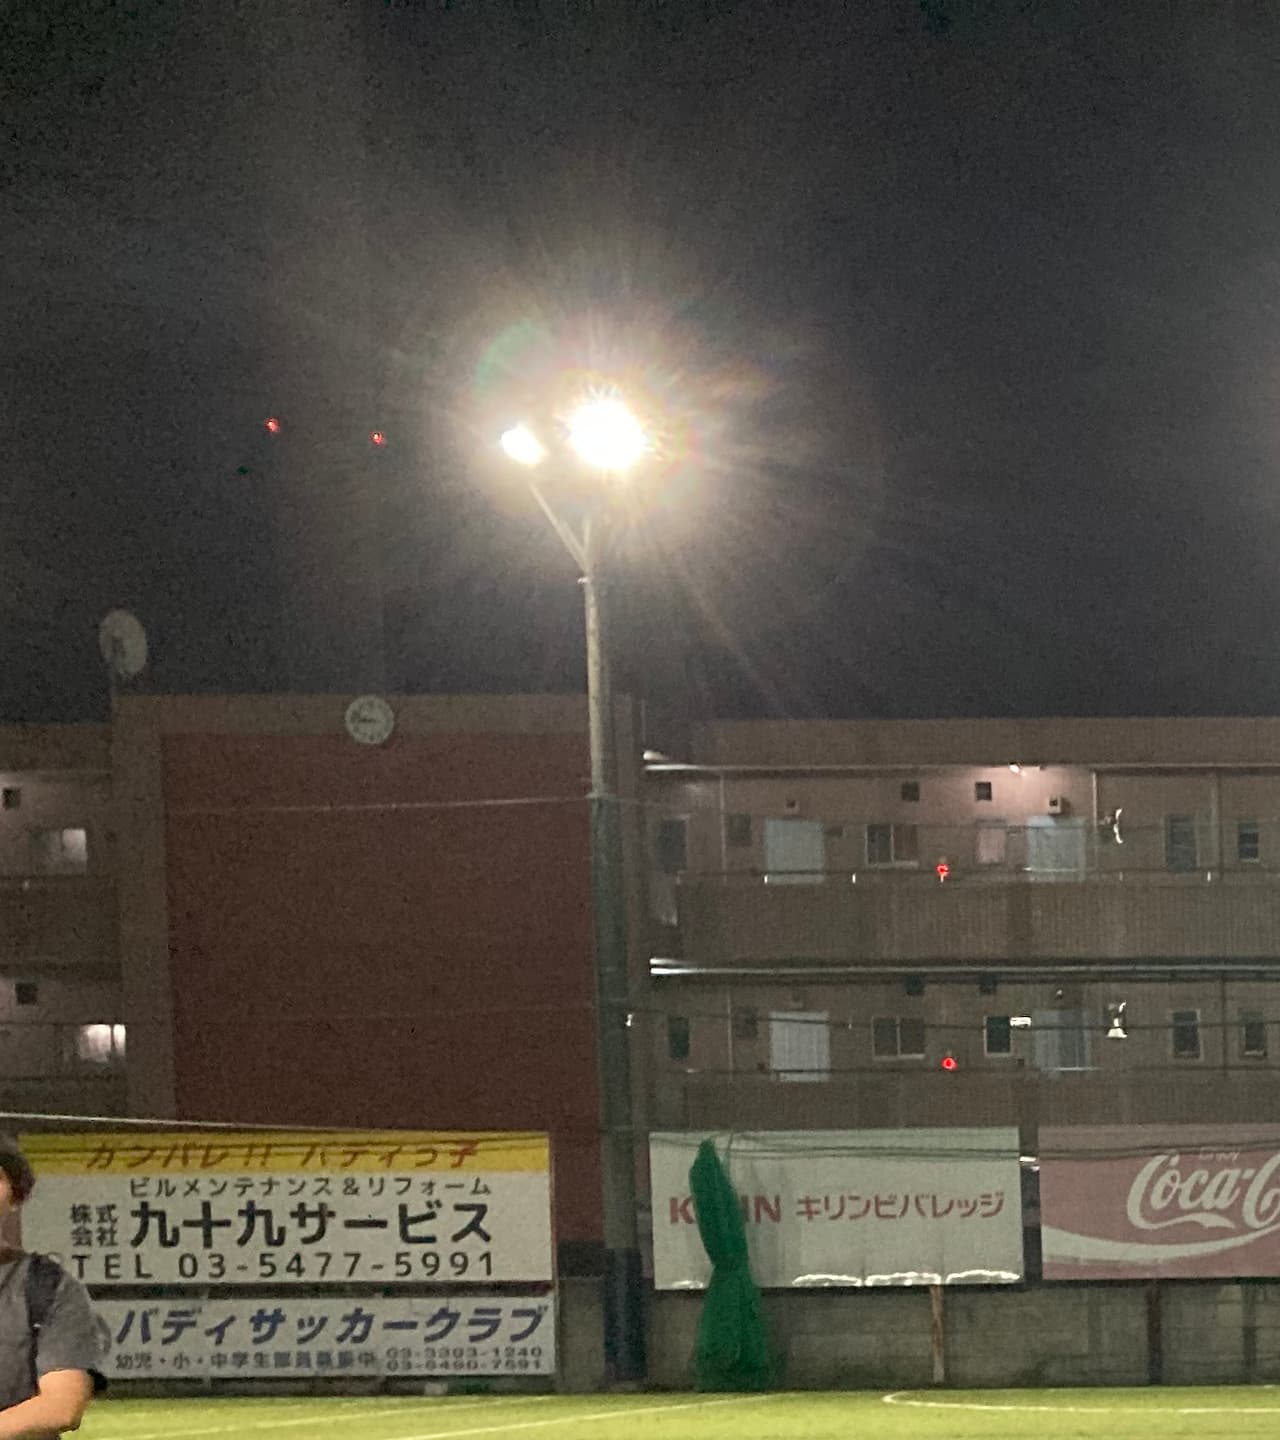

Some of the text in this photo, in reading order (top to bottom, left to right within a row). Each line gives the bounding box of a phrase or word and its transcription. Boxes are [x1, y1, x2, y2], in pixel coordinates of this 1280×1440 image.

[130, 1199, 492, 1248] 九十九サービス
[797, 1192, 1005, 1221] キリンビバレッジ
[72, 1251, 493, 1279] TEL 03-5477-5991
[115, 1305, 549, 1346] バディサッカークラブ
